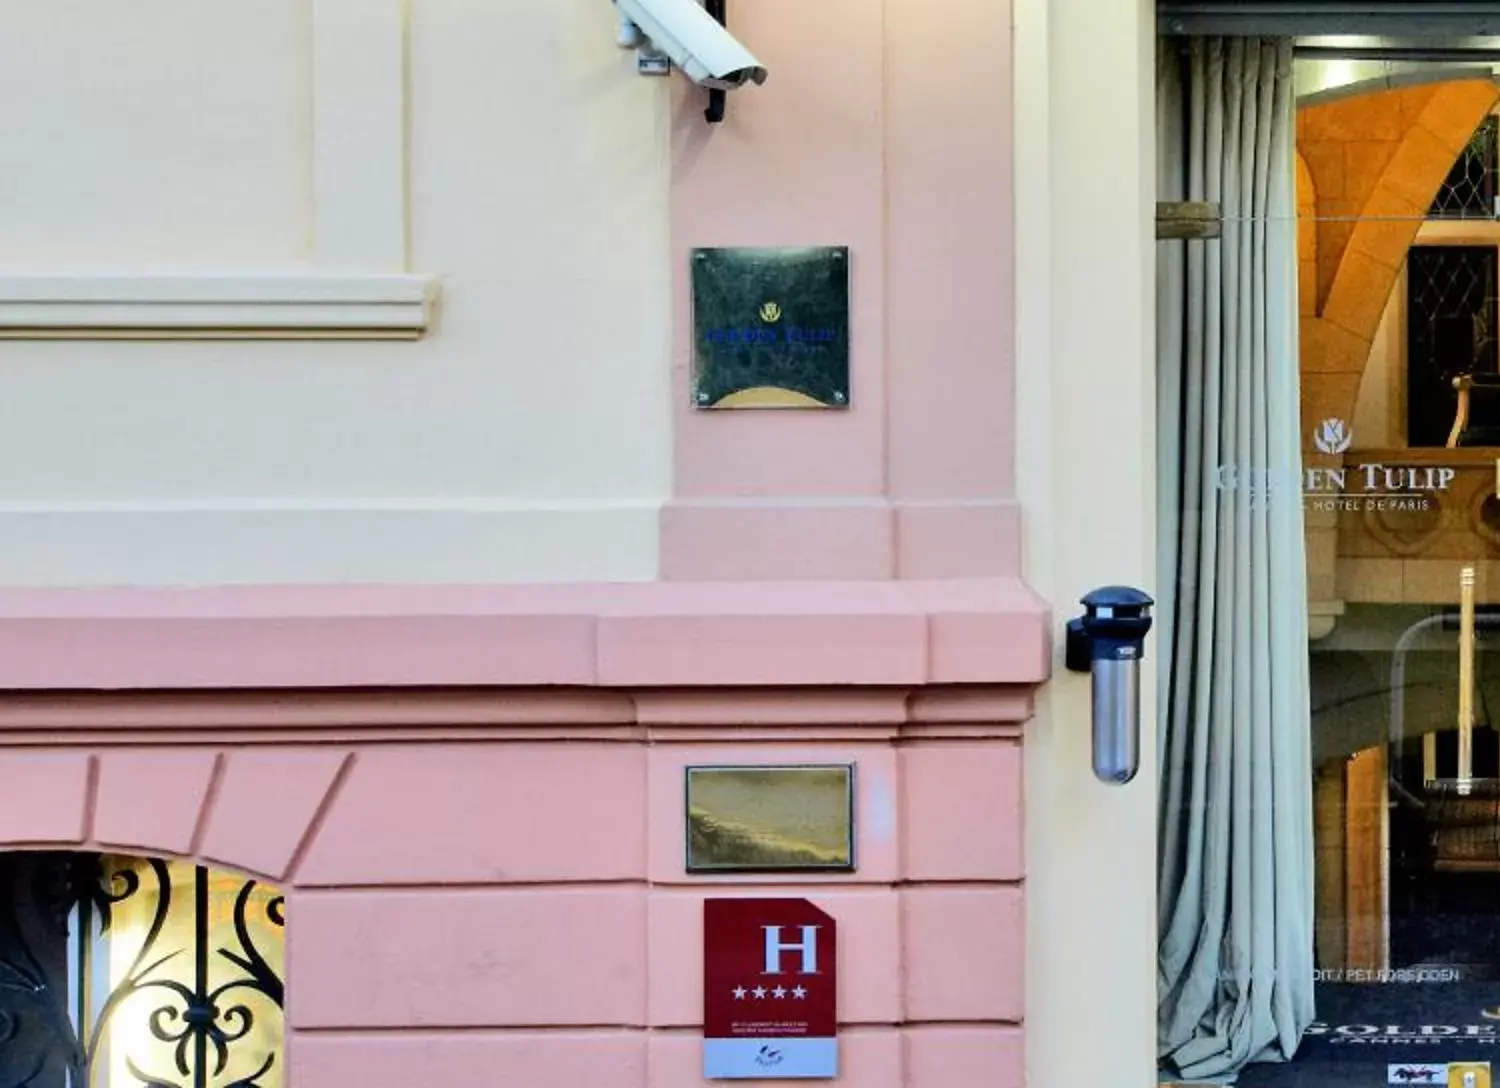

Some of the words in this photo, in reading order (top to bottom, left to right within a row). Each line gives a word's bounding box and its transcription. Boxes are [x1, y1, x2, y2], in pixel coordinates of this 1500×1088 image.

[1360, 463, 1455, 490] TULIP
[1313, 499, 1360, 512] HOTEL
[1367, 499, 1385, 512] DE
[1390, 499, 1429, 511] PARIS
[760, 924, 823, 975] H
[1346, 969, 1373, 982] PET
